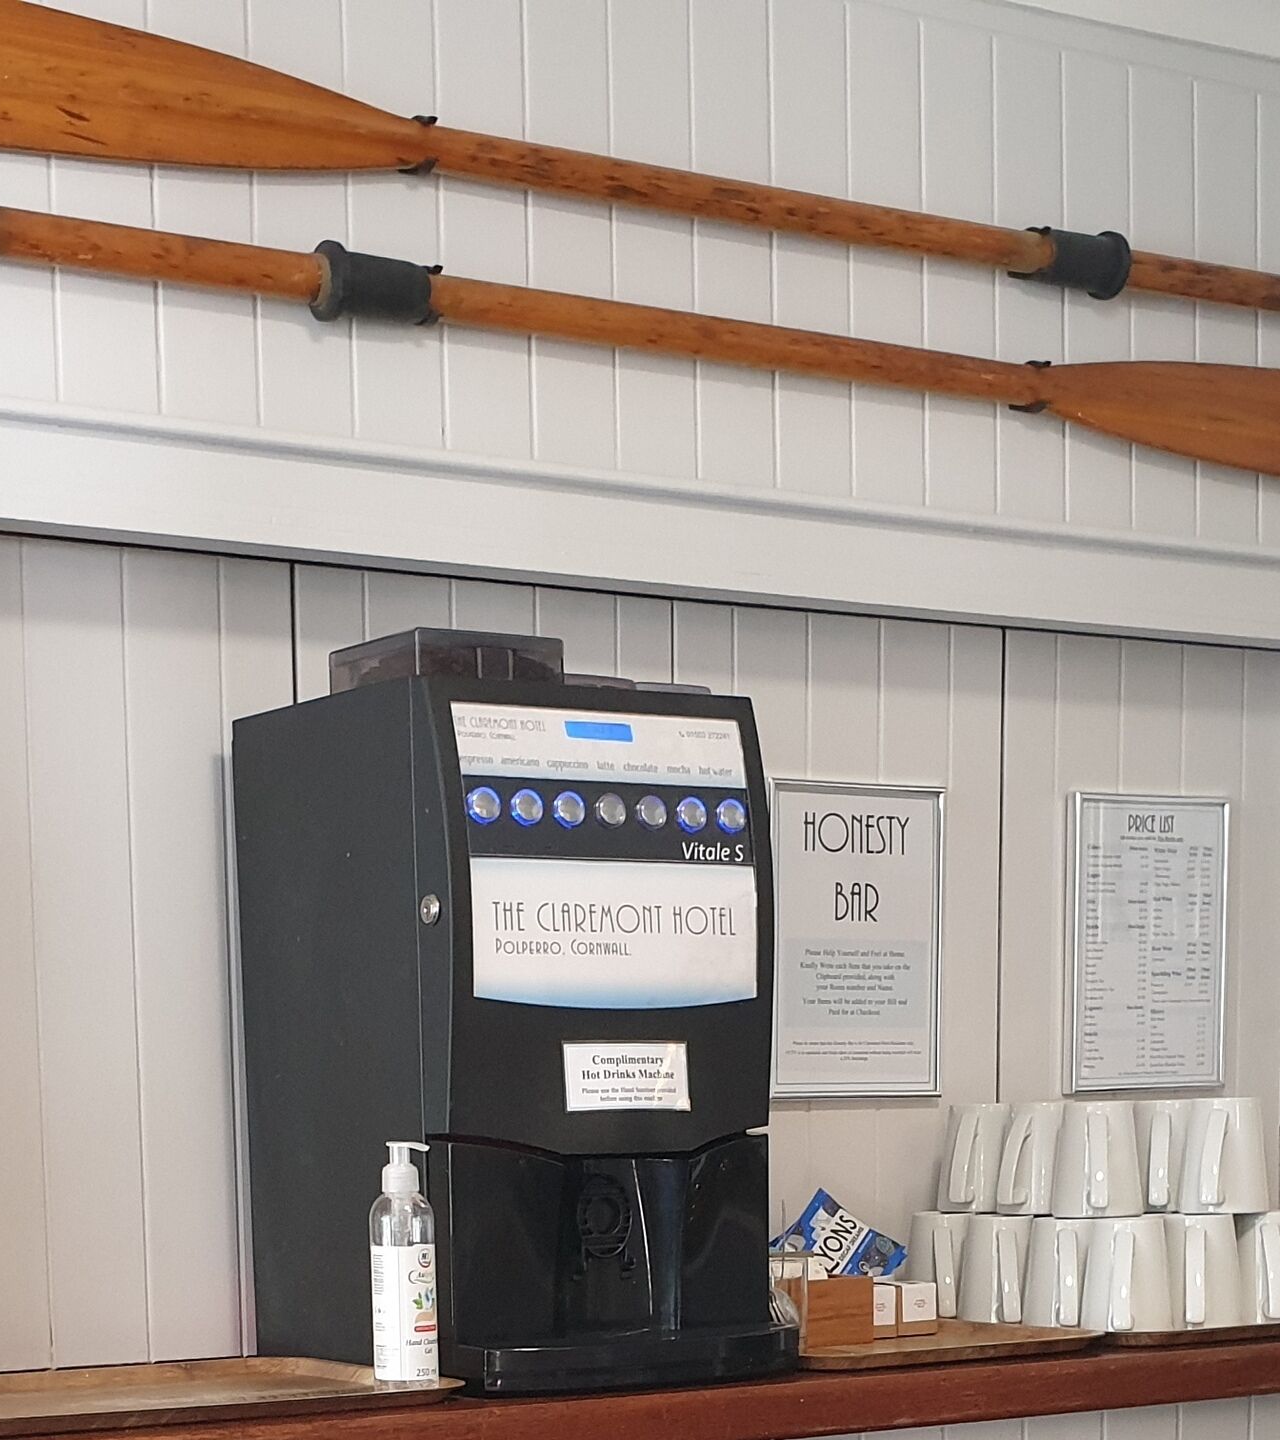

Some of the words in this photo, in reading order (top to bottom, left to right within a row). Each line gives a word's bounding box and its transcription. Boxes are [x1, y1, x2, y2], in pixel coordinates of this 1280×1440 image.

[547, 759, 589, 772] cappuccino
[1127, 814, 1156, 833] PRICE
[1159, 815, 1175, 833] LIST
[803, 811, 910, 856] HONESTY
[681, 842, 730, 861] Vitale
[734, 844, 744, 862] S
[834, 882, 880, 922] BAR
[492, 901, 525, 931] THE
[536, 902, 662, 934] CLAREMONT
[673, 905, 736, 936] HOTEL
[592, 1054, 664, 1067] Complimentary
[581, 1070, 600, 1080] Hot
[603, 1069, 636, 1079] Drinks
[814, 1214, 858, 1274] LYONS
[416, 1368, 430, 1377] 250
